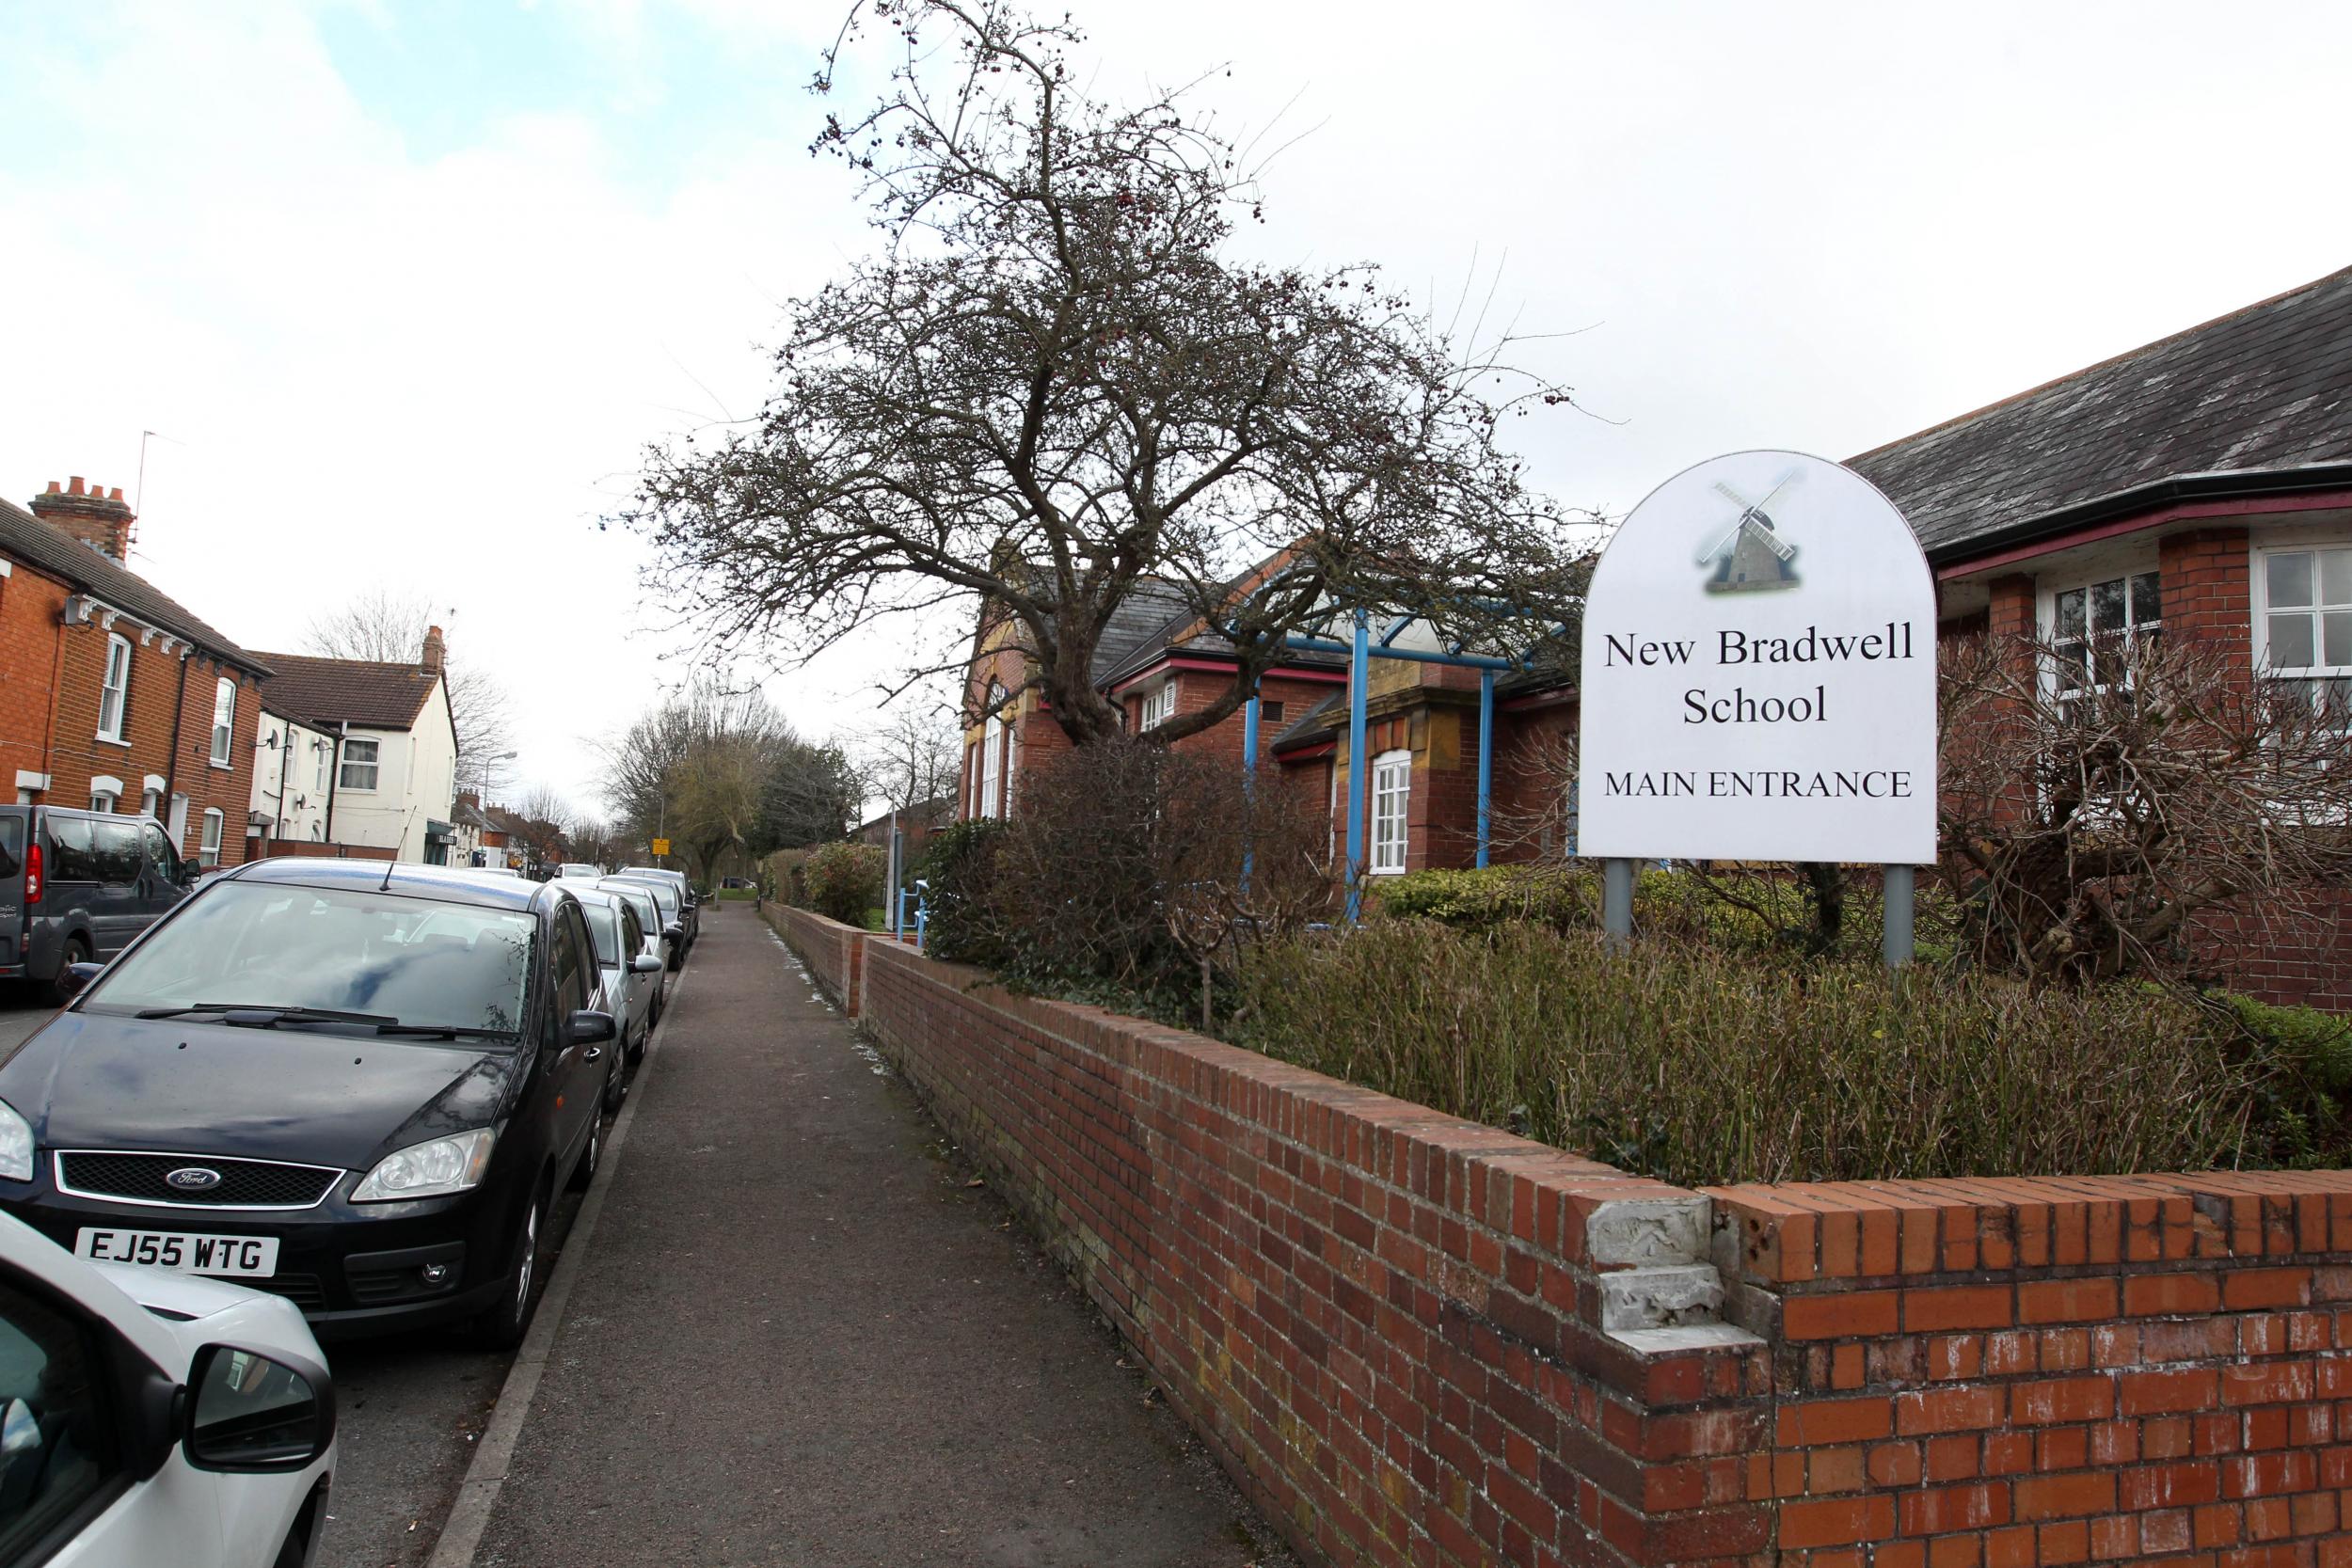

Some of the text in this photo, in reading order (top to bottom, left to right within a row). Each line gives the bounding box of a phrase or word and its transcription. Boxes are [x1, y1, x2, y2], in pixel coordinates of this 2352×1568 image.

[1604, 621, 1915, 667] New Bradwell
[1683, 685, 1828, 724] School
[1605, 770, 1913, 799] MAIN ENTRANCE
[178, 1172, 208, 1184] Ford
[89, 1231, 262, 1270] EJ55 WTG
